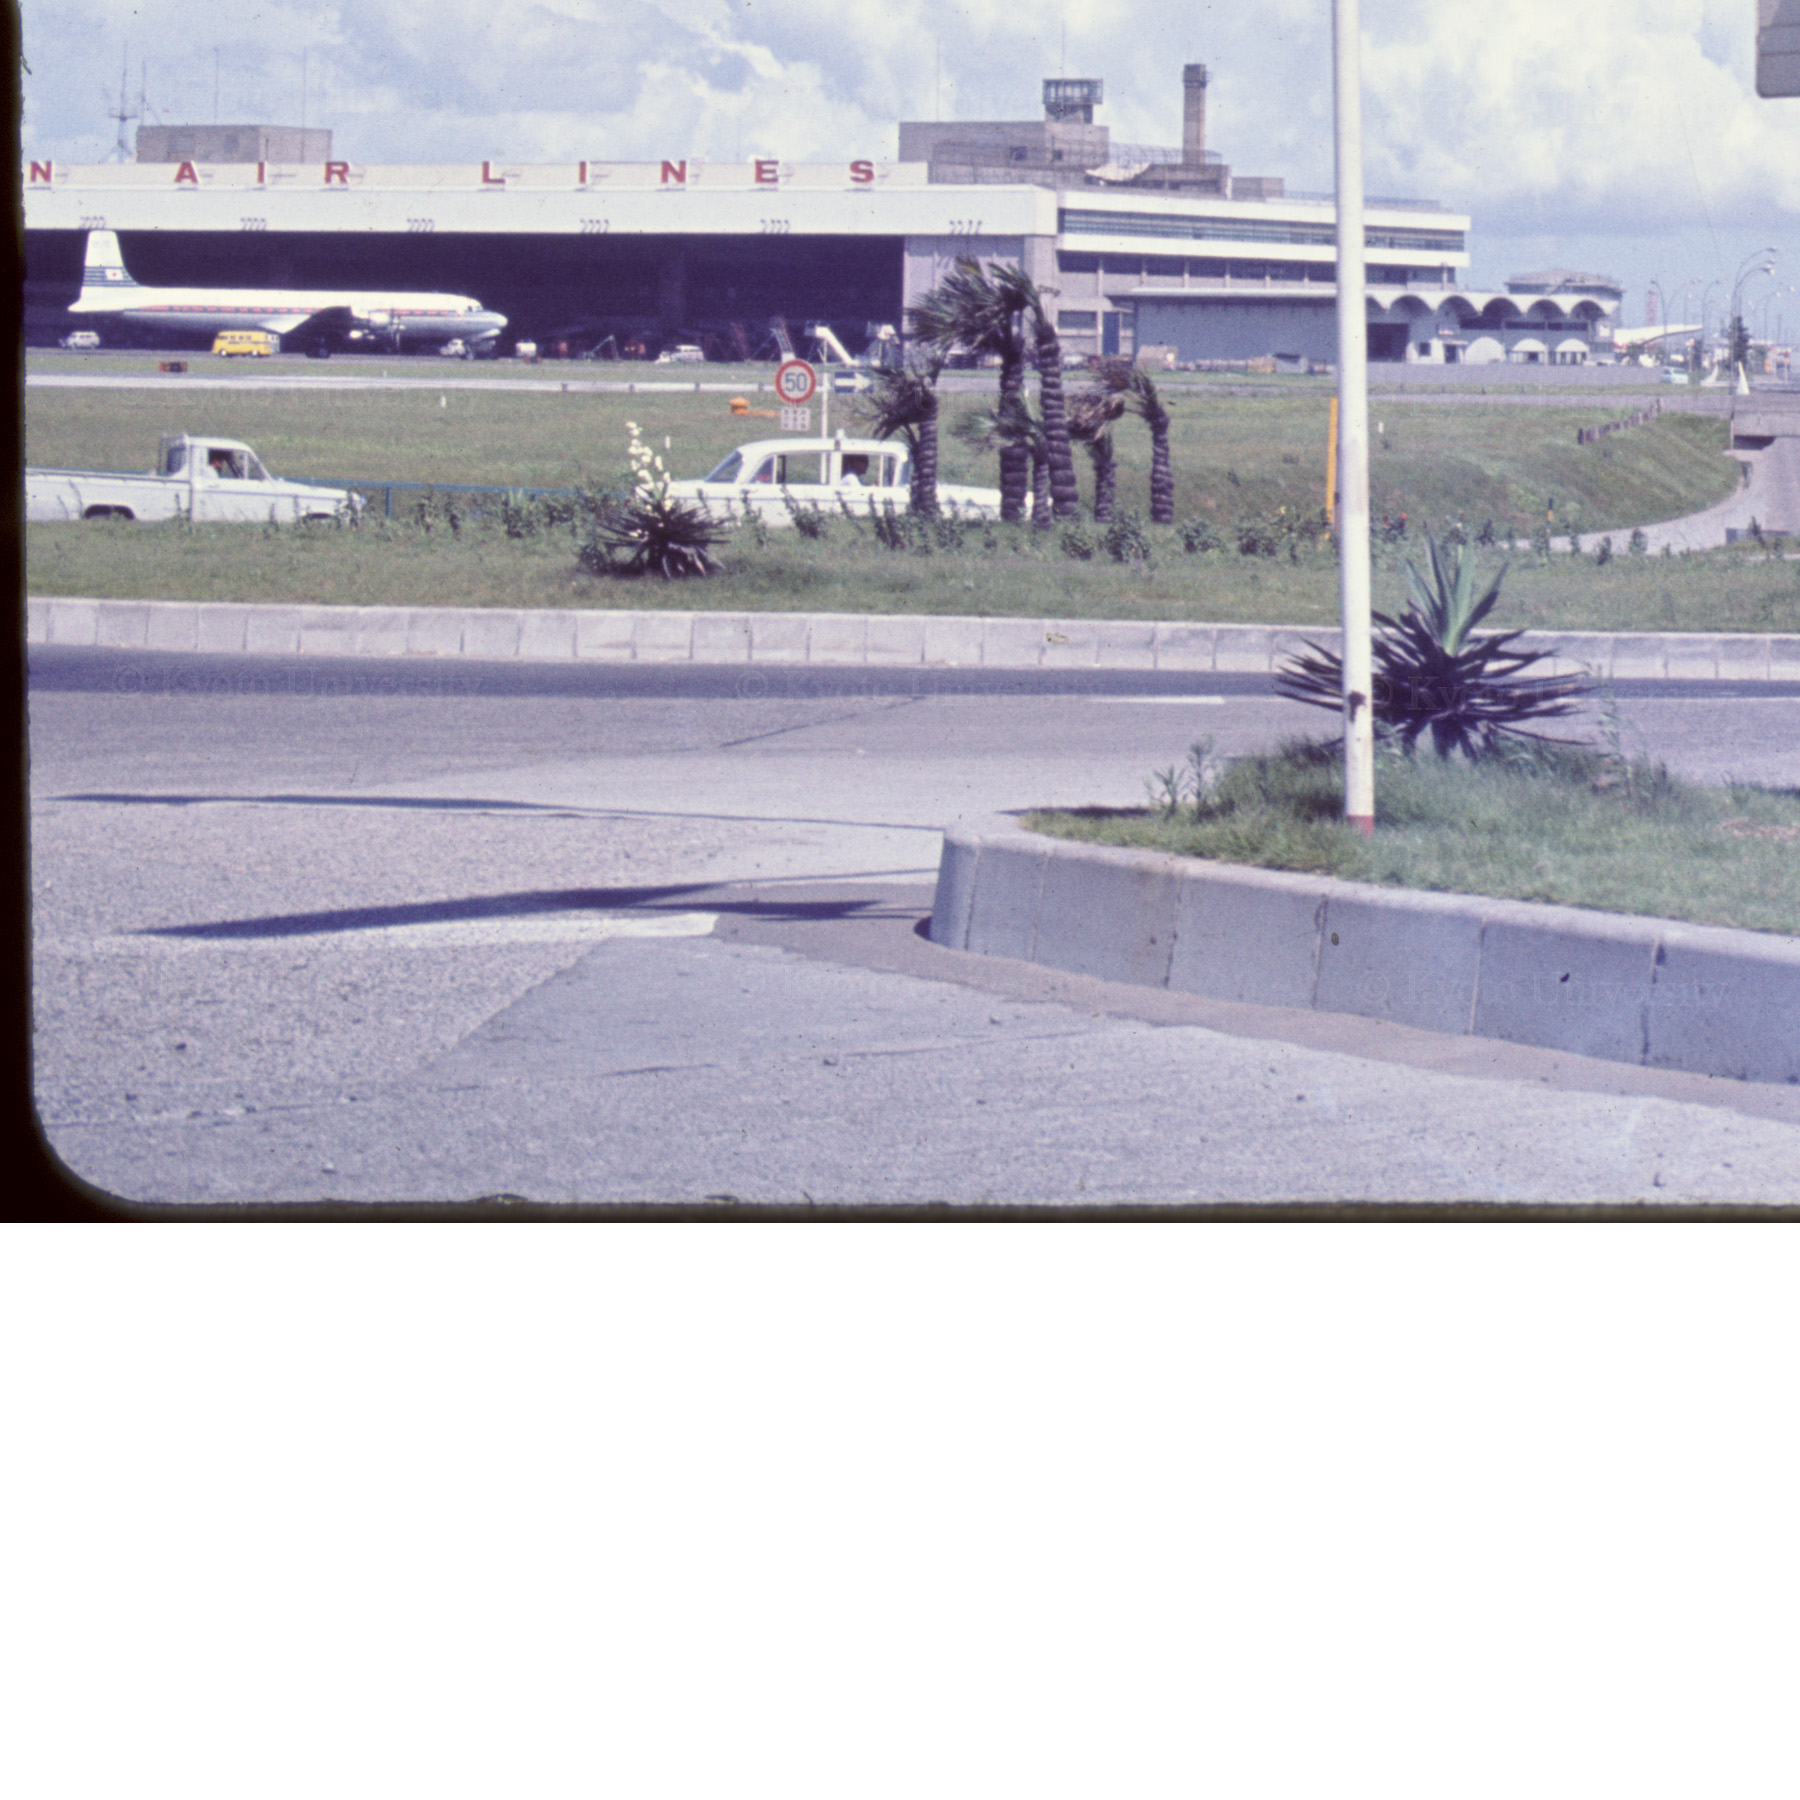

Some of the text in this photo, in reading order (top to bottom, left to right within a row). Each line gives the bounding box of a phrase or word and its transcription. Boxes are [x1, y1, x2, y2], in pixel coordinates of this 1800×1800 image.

[174, 161, 350, 184] AIR
[481, 160, 875, 185] LINES
[784, 372, 808, 392] 50
